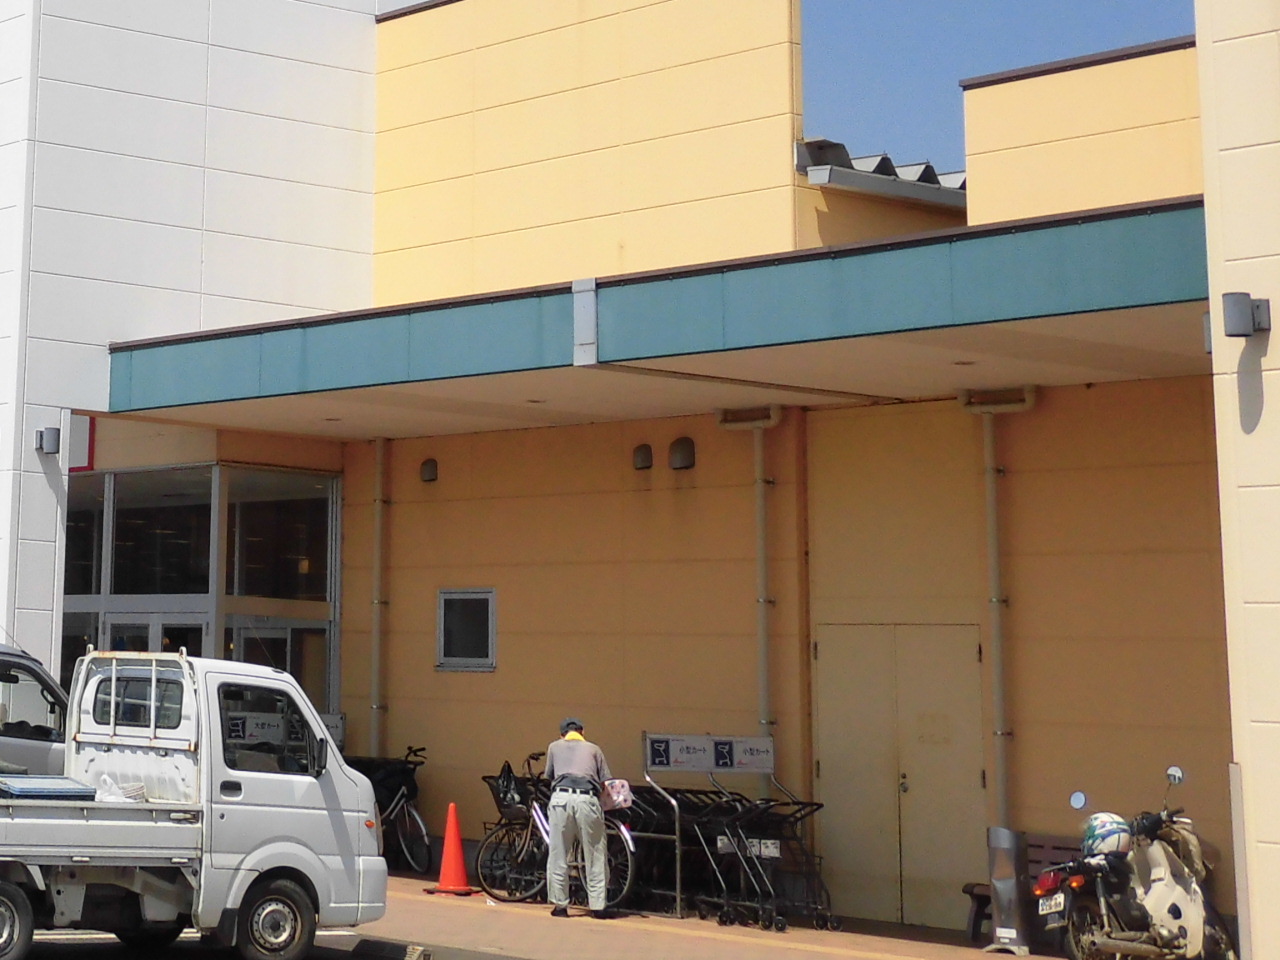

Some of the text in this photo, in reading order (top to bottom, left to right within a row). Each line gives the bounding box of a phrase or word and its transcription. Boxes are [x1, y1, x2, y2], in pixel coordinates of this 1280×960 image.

[679, 744, 708, 755] 小型カート
[743, 745, 770, 756] 小型カート
